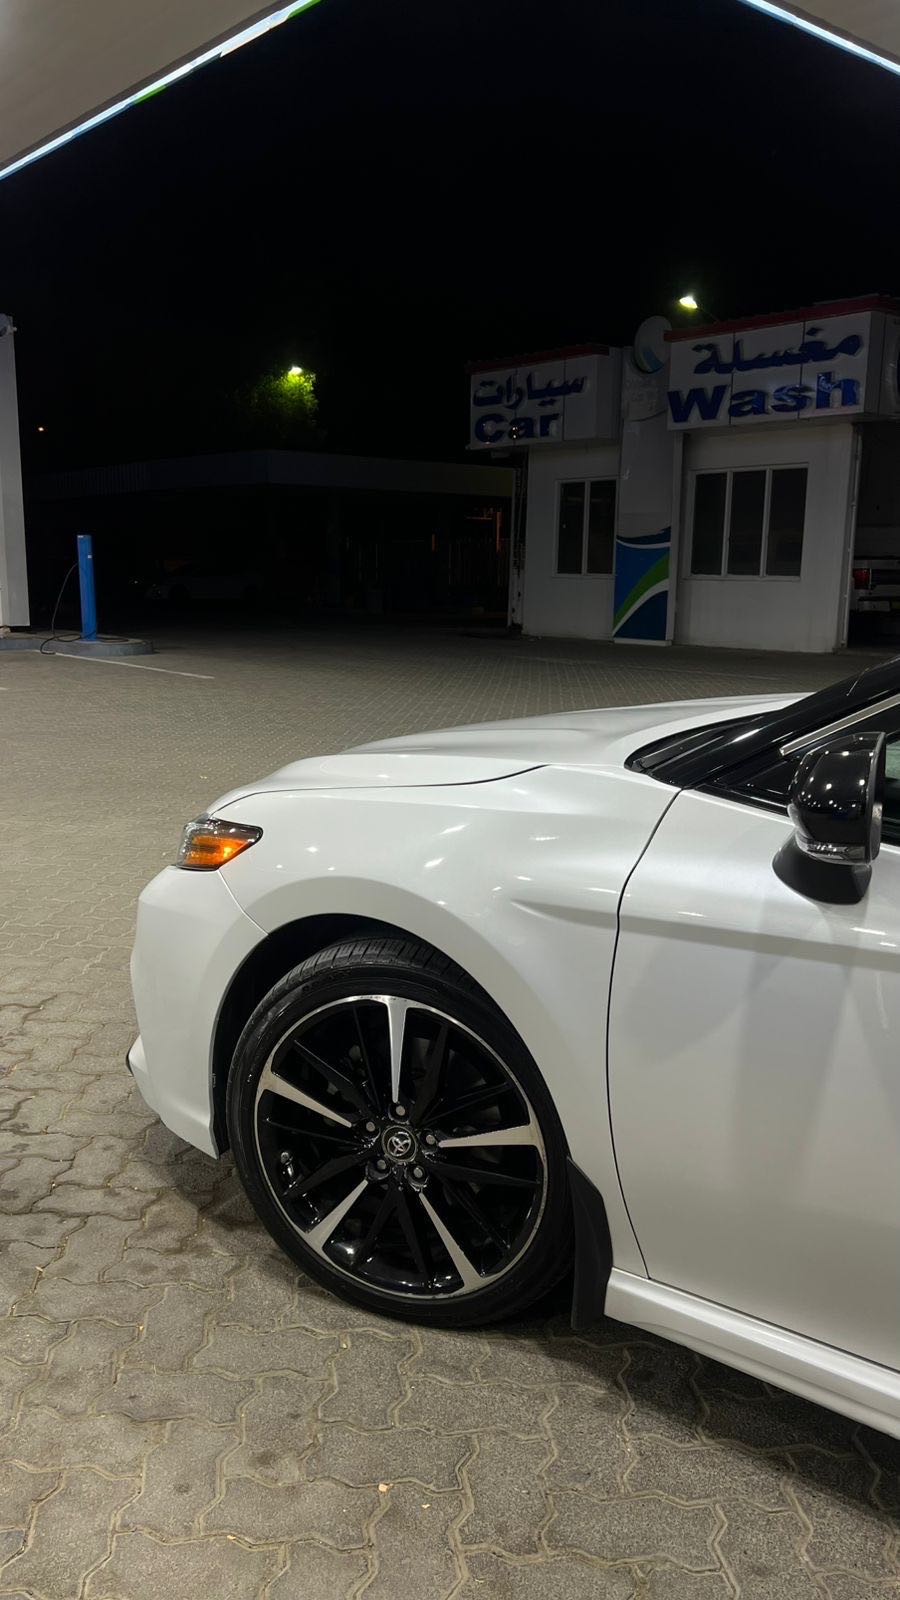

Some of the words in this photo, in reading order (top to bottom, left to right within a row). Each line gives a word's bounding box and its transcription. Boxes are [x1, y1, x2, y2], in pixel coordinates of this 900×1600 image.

[692, 327, 863, 374] مغسلة
[473, 372, 587, 409] سيارات
[667, 372, 861, 423] Wash
[475, 413, 560, 443] Car
